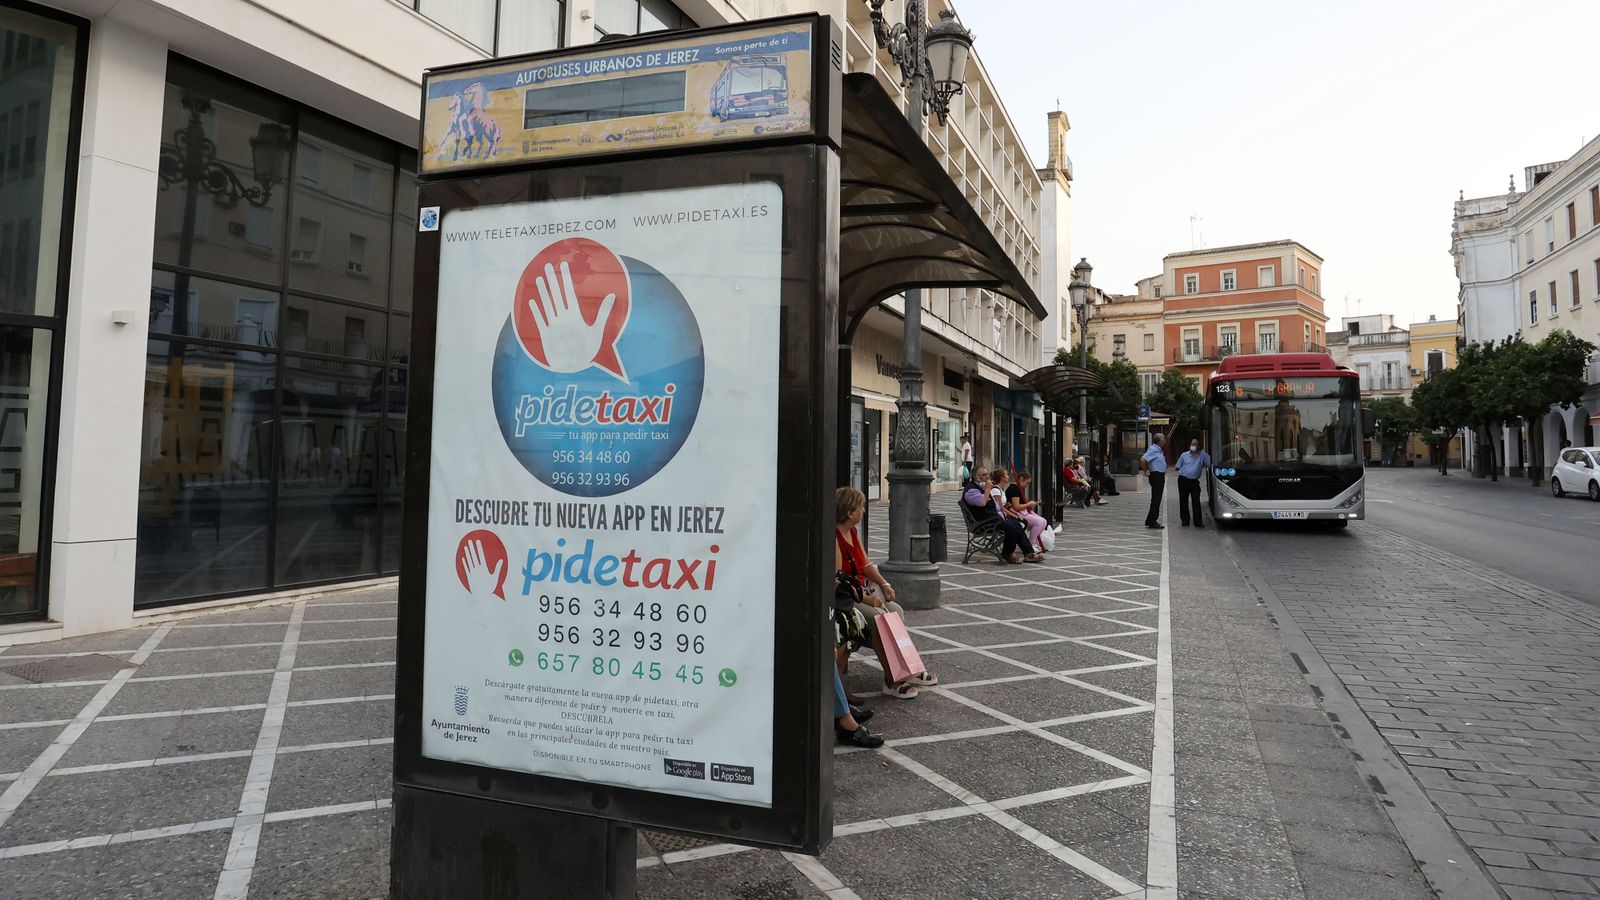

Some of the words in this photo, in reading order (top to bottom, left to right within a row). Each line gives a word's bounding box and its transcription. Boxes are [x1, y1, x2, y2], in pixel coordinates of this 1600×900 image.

[715, 46, 742, 55] Somos
[744, 42, 767, 52] parte
[769, 38, 780, 46] de
[515, 62, 581, 86] AUTOBUSES
[584, 54, 642, 74] URBANOS
[646, 54, 662, 66] DE
[665, 49, 699, 65] JEREZ
[446, 218, 616, 243] WWW.TELETAXIJEREZ.COM
[634, 205, 768, 228] WWW.PIDETAXI.ES
[1216, 385, 1230, 393] 123
[1277, 382, 1315, 396] GRANJA
[515, 383, 676, 437] pidetaxi
[569, 431, 579, 440] tu
[581, 432, 597, 445] app
[600, 432, 621, 445] para
[623, 429, 648, 445] pedir
[651, 429, 669, 440] taxi
[552, 450, 574, 464] 956
[578, 451, 593, 464] 34
[596, 451, 612, 464] 48
[615, 451, 630, 464] 60
[552, 472, 574, 485] 956
[577, 473, 593, 485] 32
[595, 473, 611, 486] 93
[614, 473, 630, 486] 96
[455, 498, 529, 526] DESCUBRE
[533, 501, 552, 527] TU
[556, 503, 607, 530] NUEVA
[612, 504, 646, 531] APP
[651, 506, 671, 533] EN
[676, 506, 725, 534] JEREZ
[522, 538, 720, 596] pidetaxi
[539, 595, 581, 616] 956
[593, 599, 621, 619] 34
[633, 602, 662, 622] 48
[676, 604, 707, 624] 60
[538, 623, 580, 644] 956
[592, 628, 621, 648] 32
[633, 631, 662, 651] 93
[676, 634, 705, 655] 96
[537, 652, 580, 673] 657
[592, 657, 621, 677] 80
[632, 661, 662, 681] 45
[675, 664, 704, 685] 45
[484, 679, 525, 691] Descárgate
[527, 684, 579, 697] gratuitamente
[581, 688, 589, 697] la
[591, 691, 613, 700] nueva
[616, 694, 631, 704] app
[632, 693, 642, 703] de
[681, 700, 699, 709] otra
[504, 694, 533, 703] manera
[535, 693, 567, 708] diferente
[569, 699, 579, 708] de
[581, 700, 601, 712] pedir
[600, 705, 607, 714] y
[611, 706, 643, 716] moverte
[657, 709, 676, 719] taxi.
[431, 719, 490, 735] Ayuntamiento
[444, 730, 454, 739] de
[456, 731, 477, 743] Jerez
[488, 714, 522, 726] Recuerda
[523, 720, 536, 729] que
[538, 720, 563, 733] puedes
[565, 724, 592, 735] utilizar
[595, 727, 603, 736] la
[605, 730, 620, 740] app
[622, 731, 640, 741] para
[643, 732, 663, 744] pedir
[666, 735, 674, 744] tu
[677, 736, 694, 746] taxi
[517, 729, 528, 739] las
[530, 732, 572, 744] principales
[573, 737, 607, 749] ciudades
[609, 740, 618, 750] de
[620, 744, 651, 753] nuestro
[653, 745, 671, 757] país.
[533, 750, 574, 762] DISPONIBLE
[576, 754, 586, 763] EN
[588, 755, 597, 764] TU
[600, 759, 652, 771] SMARTPHONE
[672, 765, 692, 777] Google
[692, 768, 704, 779] play
[720, 771, 734, 783] App
[734, 772, 752, 783] Store
